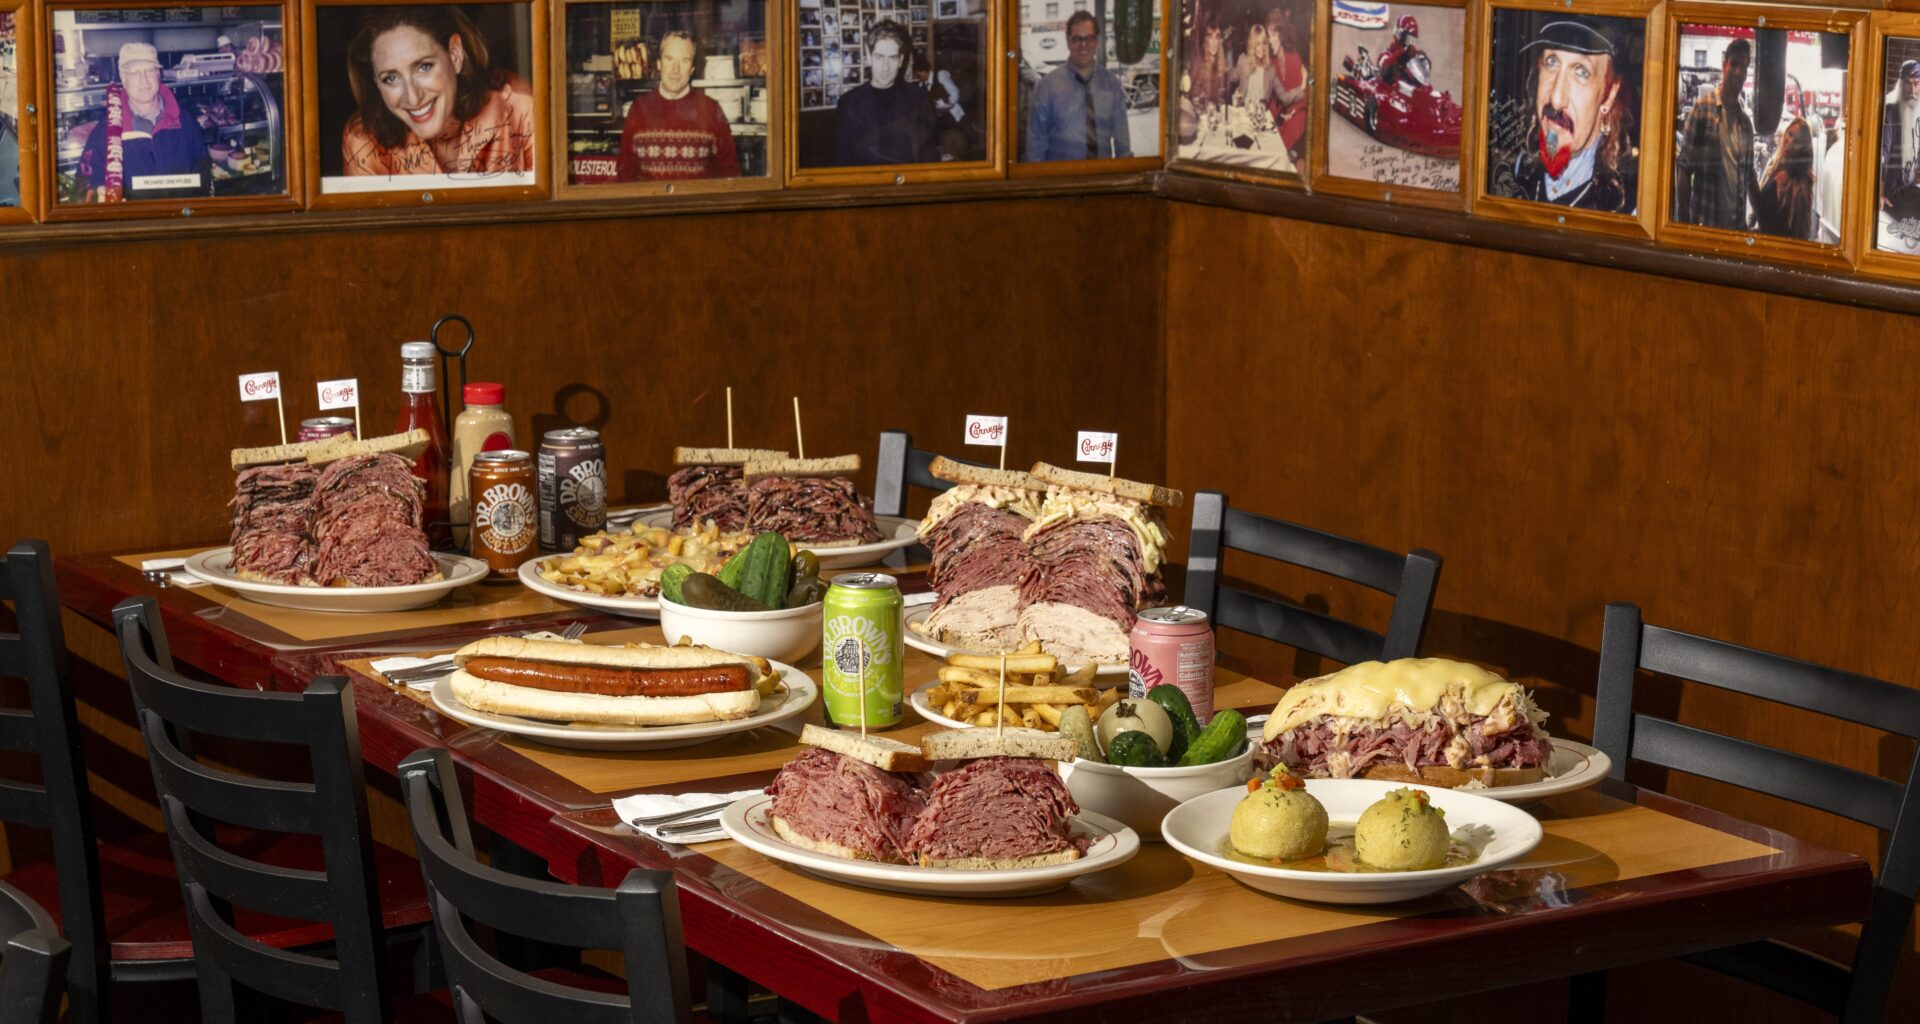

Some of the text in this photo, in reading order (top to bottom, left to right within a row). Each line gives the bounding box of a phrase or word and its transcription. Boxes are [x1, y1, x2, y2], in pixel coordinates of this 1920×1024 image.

[244, 378, 277, 396] Carnegie
[322, 386, 355, 404] Carnegie
[969, 421, 1004, 440] Carnegie
[1081, 438, 1113, 457] Carnegie
